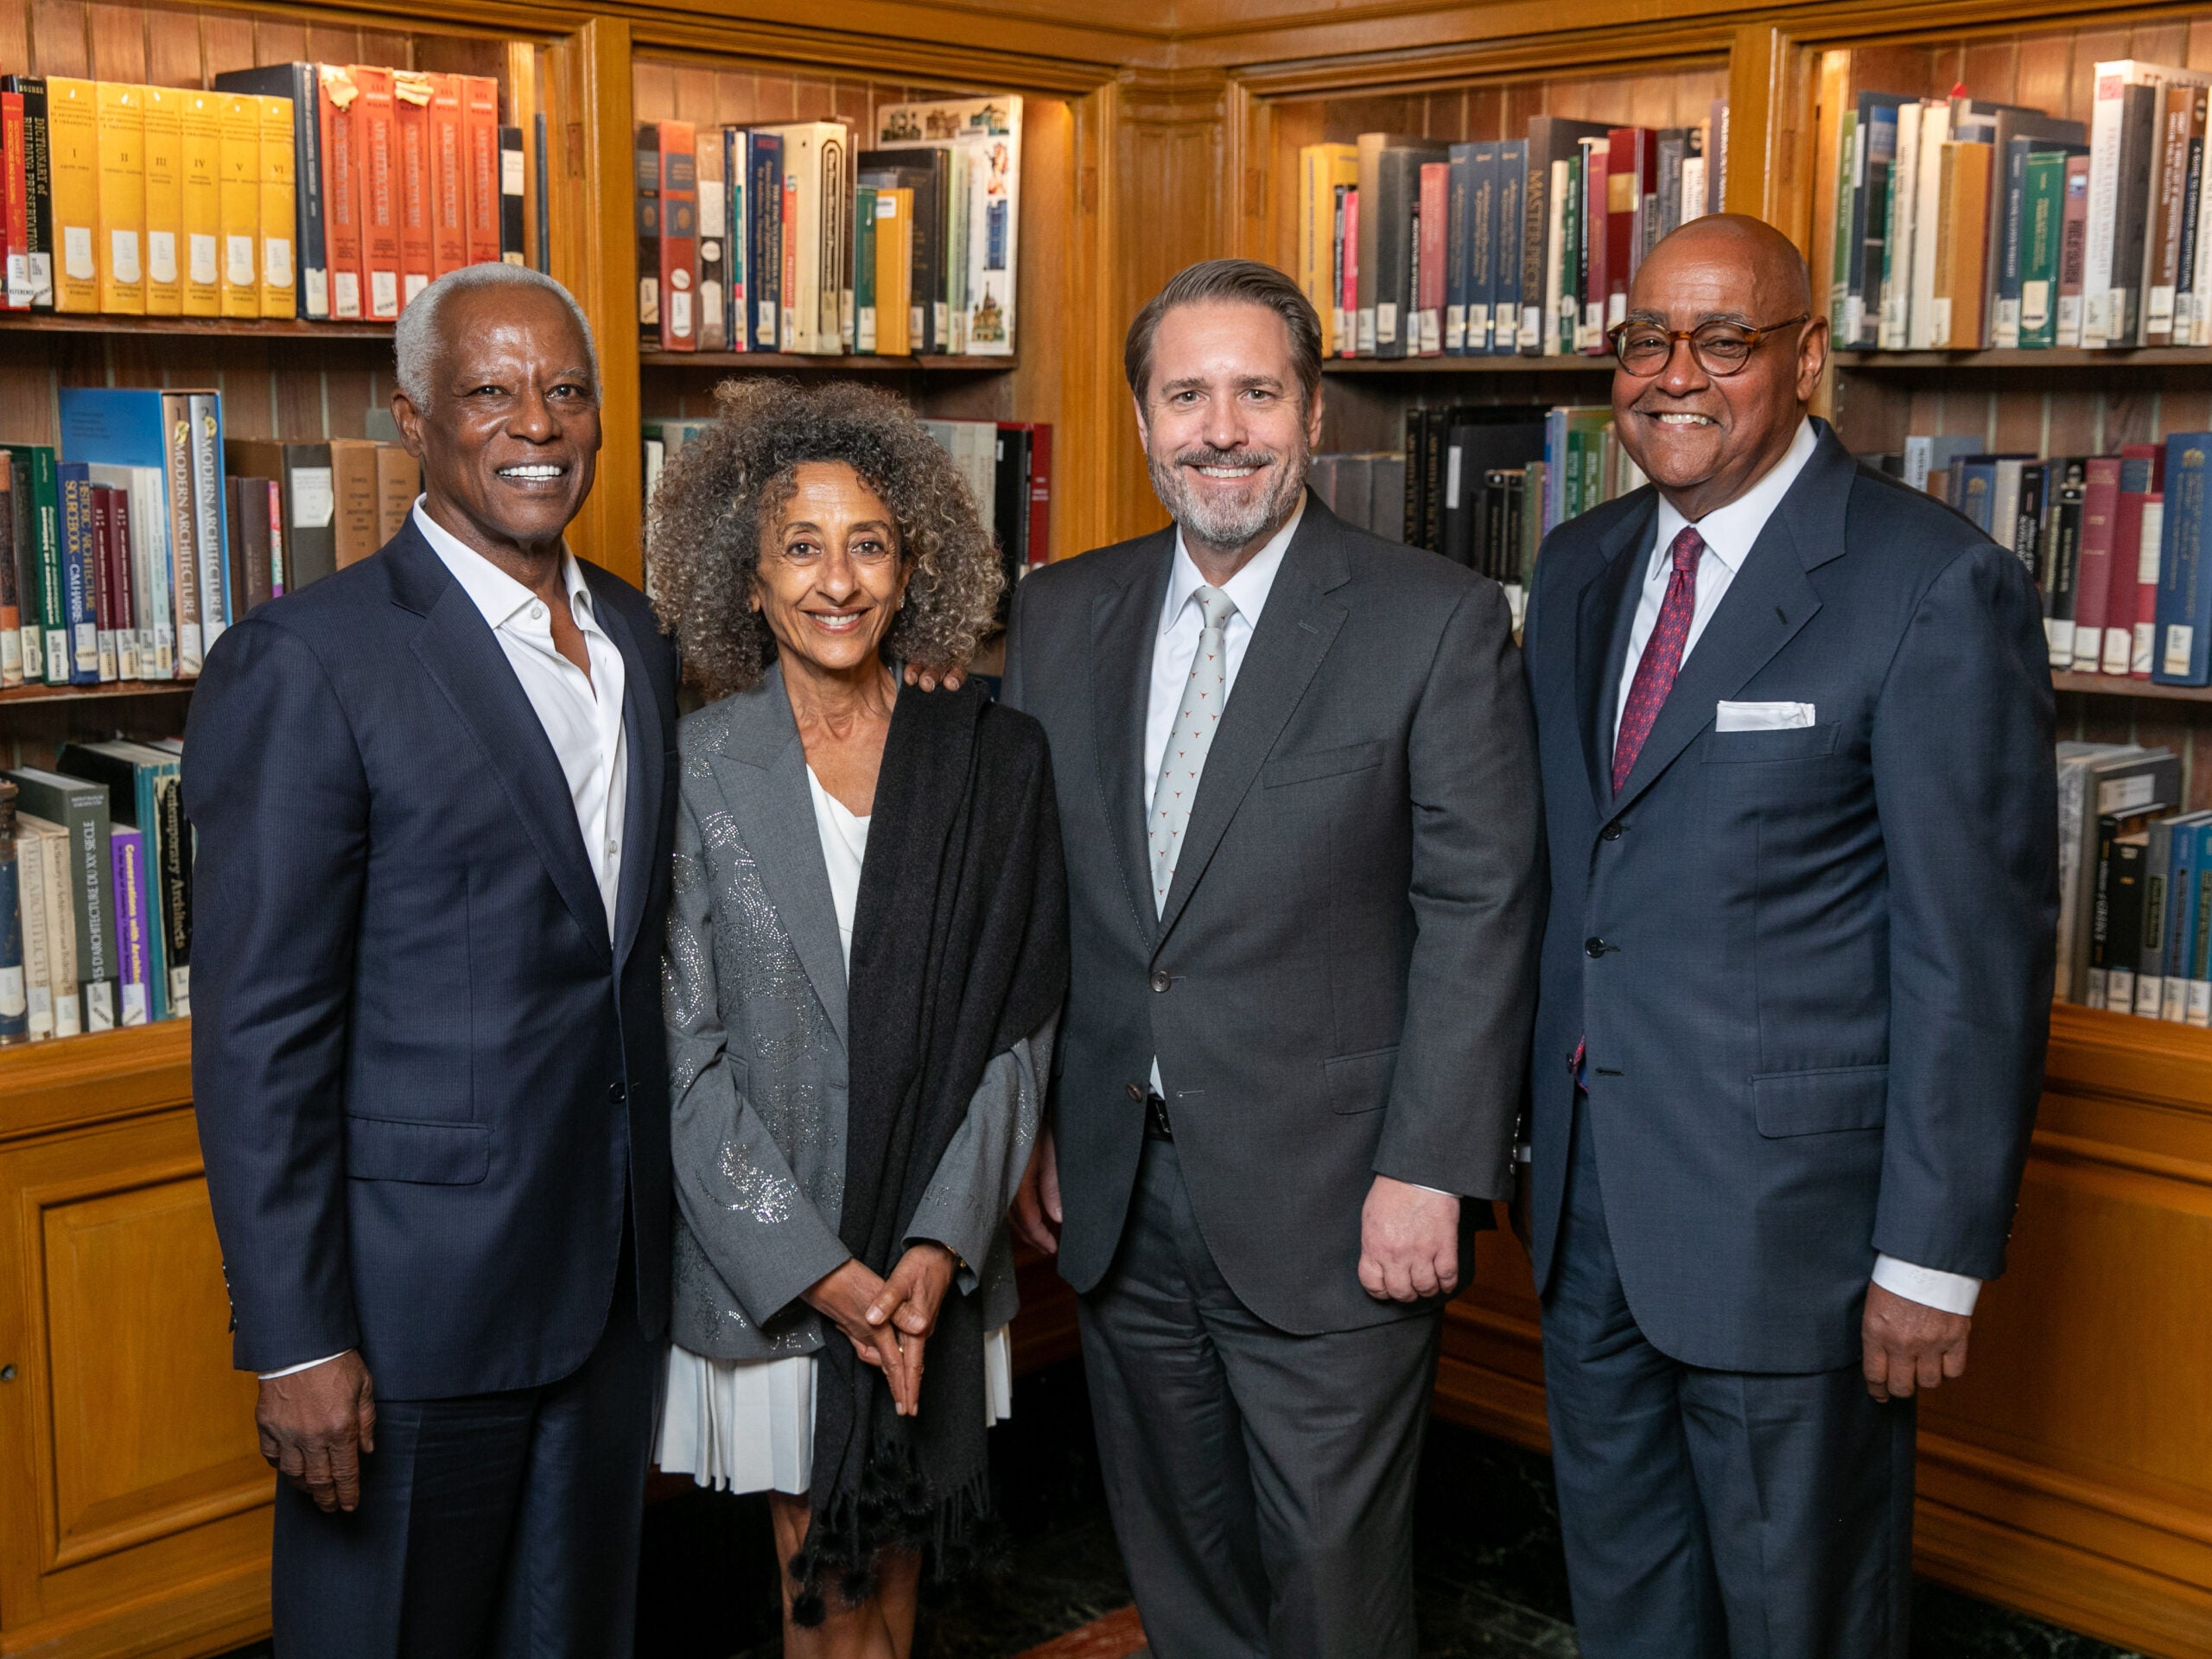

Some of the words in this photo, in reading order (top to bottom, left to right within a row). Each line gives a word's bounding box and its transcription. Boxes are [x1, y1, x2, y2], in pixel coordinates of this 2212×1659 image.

[23, 117, 36, 169] BUILDING
[34, 118, 46, 181] DICTIONARY
[73, 149, 76, 157] I
[121, 153, 128, 162] II
[156, 157, 166, 166] III
[194, 159, 206, 168] IV
[235, 163, 244, 172] V
[274, 165, 284, 174] VI
[335, 117, 349, 225] ARCHITECTURE
[2106, 127, 2117, 169] FRANK
[2191, 154, 2200, 177] GUIDE
[37, 184, 48, 194] of
[375, 119, 389, 227] ARCHITECTURE
[406, 123, 421, 229] ARCHITECTURE
[443, 123, 457, 229] ARCHITECTURE
[477, 127, 490, 231] ARCHITECTURE
[2102, 175, 2113, 218] LLOYD
[2191, 179, 2198, 188] TO
[24, 173, 39, 253] PRESERVATION
[1525, 169, 1543, 301] MASTERPIECES
[2188, 190, 2197, 227] CANADIAN
[824, 240, 834, 292] Preservatio
[2098, 221, 2111, 275] WRIGHT
[2183, 229, 2195, 288] ARCHITECTURAL
[173, 442, 191, 508] MODERN
[200, 437, 217, 505] MODERN
[65, 480, 79, 554] SOURCEBOOK
[79, 480, 92, 528] HISTORIC
[43, 552, 50, 563] et
[82, 532, 96, 611] ARCHITECTURE
[176, 511, 194, 615] ARCHITECTURE
[204, 506, 222, 610] ARCHITECTURE
[44, 566, 54, 625] architecture
[51, 567, 60, 624] architecture
[166, 779, 181, 874] Contemporary
[86, 869, 99, 885] DU
[125, 844, 138, 917] Conversations
[29, 883, 47, 988] ARCHITECTUR
[88, 886, 104, 964] D'ARCHITECTURE
[130, 918, 139, 941] with
[171, 879, 187, 948] Architects
[130, 944, 142, 984] Architec
